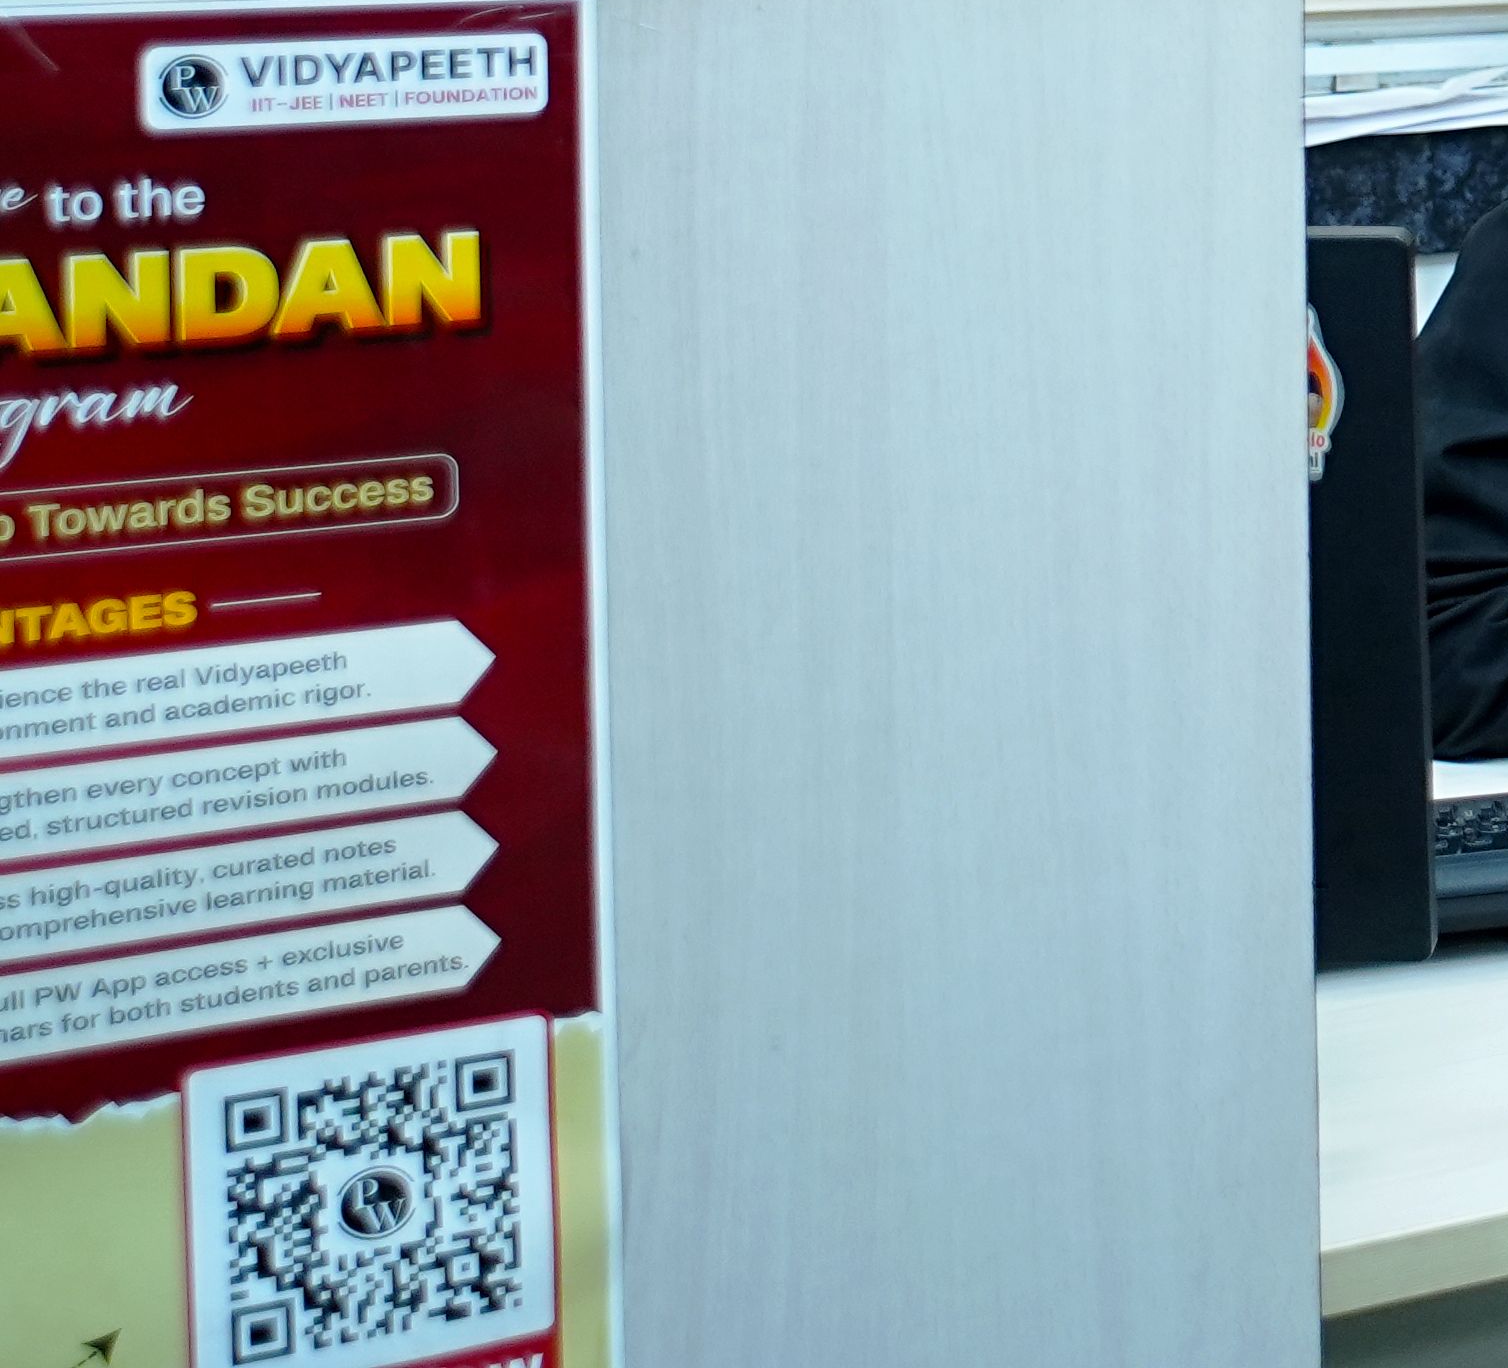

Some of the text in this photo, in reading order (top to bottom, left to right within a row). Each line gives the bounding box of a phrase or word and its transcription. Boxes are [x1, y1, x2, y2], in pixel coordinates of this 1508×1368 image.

[241, 44, 539, 89] VIDYAPEETH
[250, 85, 539, 113] IIT-JEE NEET FOUNDATION
[50, 185, 104, 223] to
[118, 177, 207, 220] the
[0, 230, 482, 352] ANDAN
[28, 488, 232, 537] Towards
[242, 470, 435, 520] Success
[81, 678, 128, 700] the
[136, 668, 187, 694] real
[195, 650, 348, 687] Vidyapeeth
[105, 703, 156, 728] and
[165, 688, 296, 721] academic
[304, 681, 372, 707] rigor.
[87, 774, 164, 800] every
[172, 757, 282, 788] concept
[290, 748, 347, 774] with
[46, 797, 193, 836] structured
[202, 784, 308, 816] revision
[317, 770, 435, 800] modules.
[30, 865, 205, 908] high-quality,
[212, 845, 316, 880] curated
[324, 838, 398, 864] notes
[206, 880, 314, 912] learning
[323, 858, 436, 894] material.
[35, 982, 82, 1009] PW
[91, 975, 147, 1000] App
[154, 957, 249, 988] access
[257, 955, 273, 972] +
[282, 933, 405, 968] exclusive
[60, 1011, 101, 1034] for
[108, 998, 172, 1026] both
[179, 979, 300, 1014] students
[307, 967, 356, 994] and
[364, 954, 470, 989] parents.
